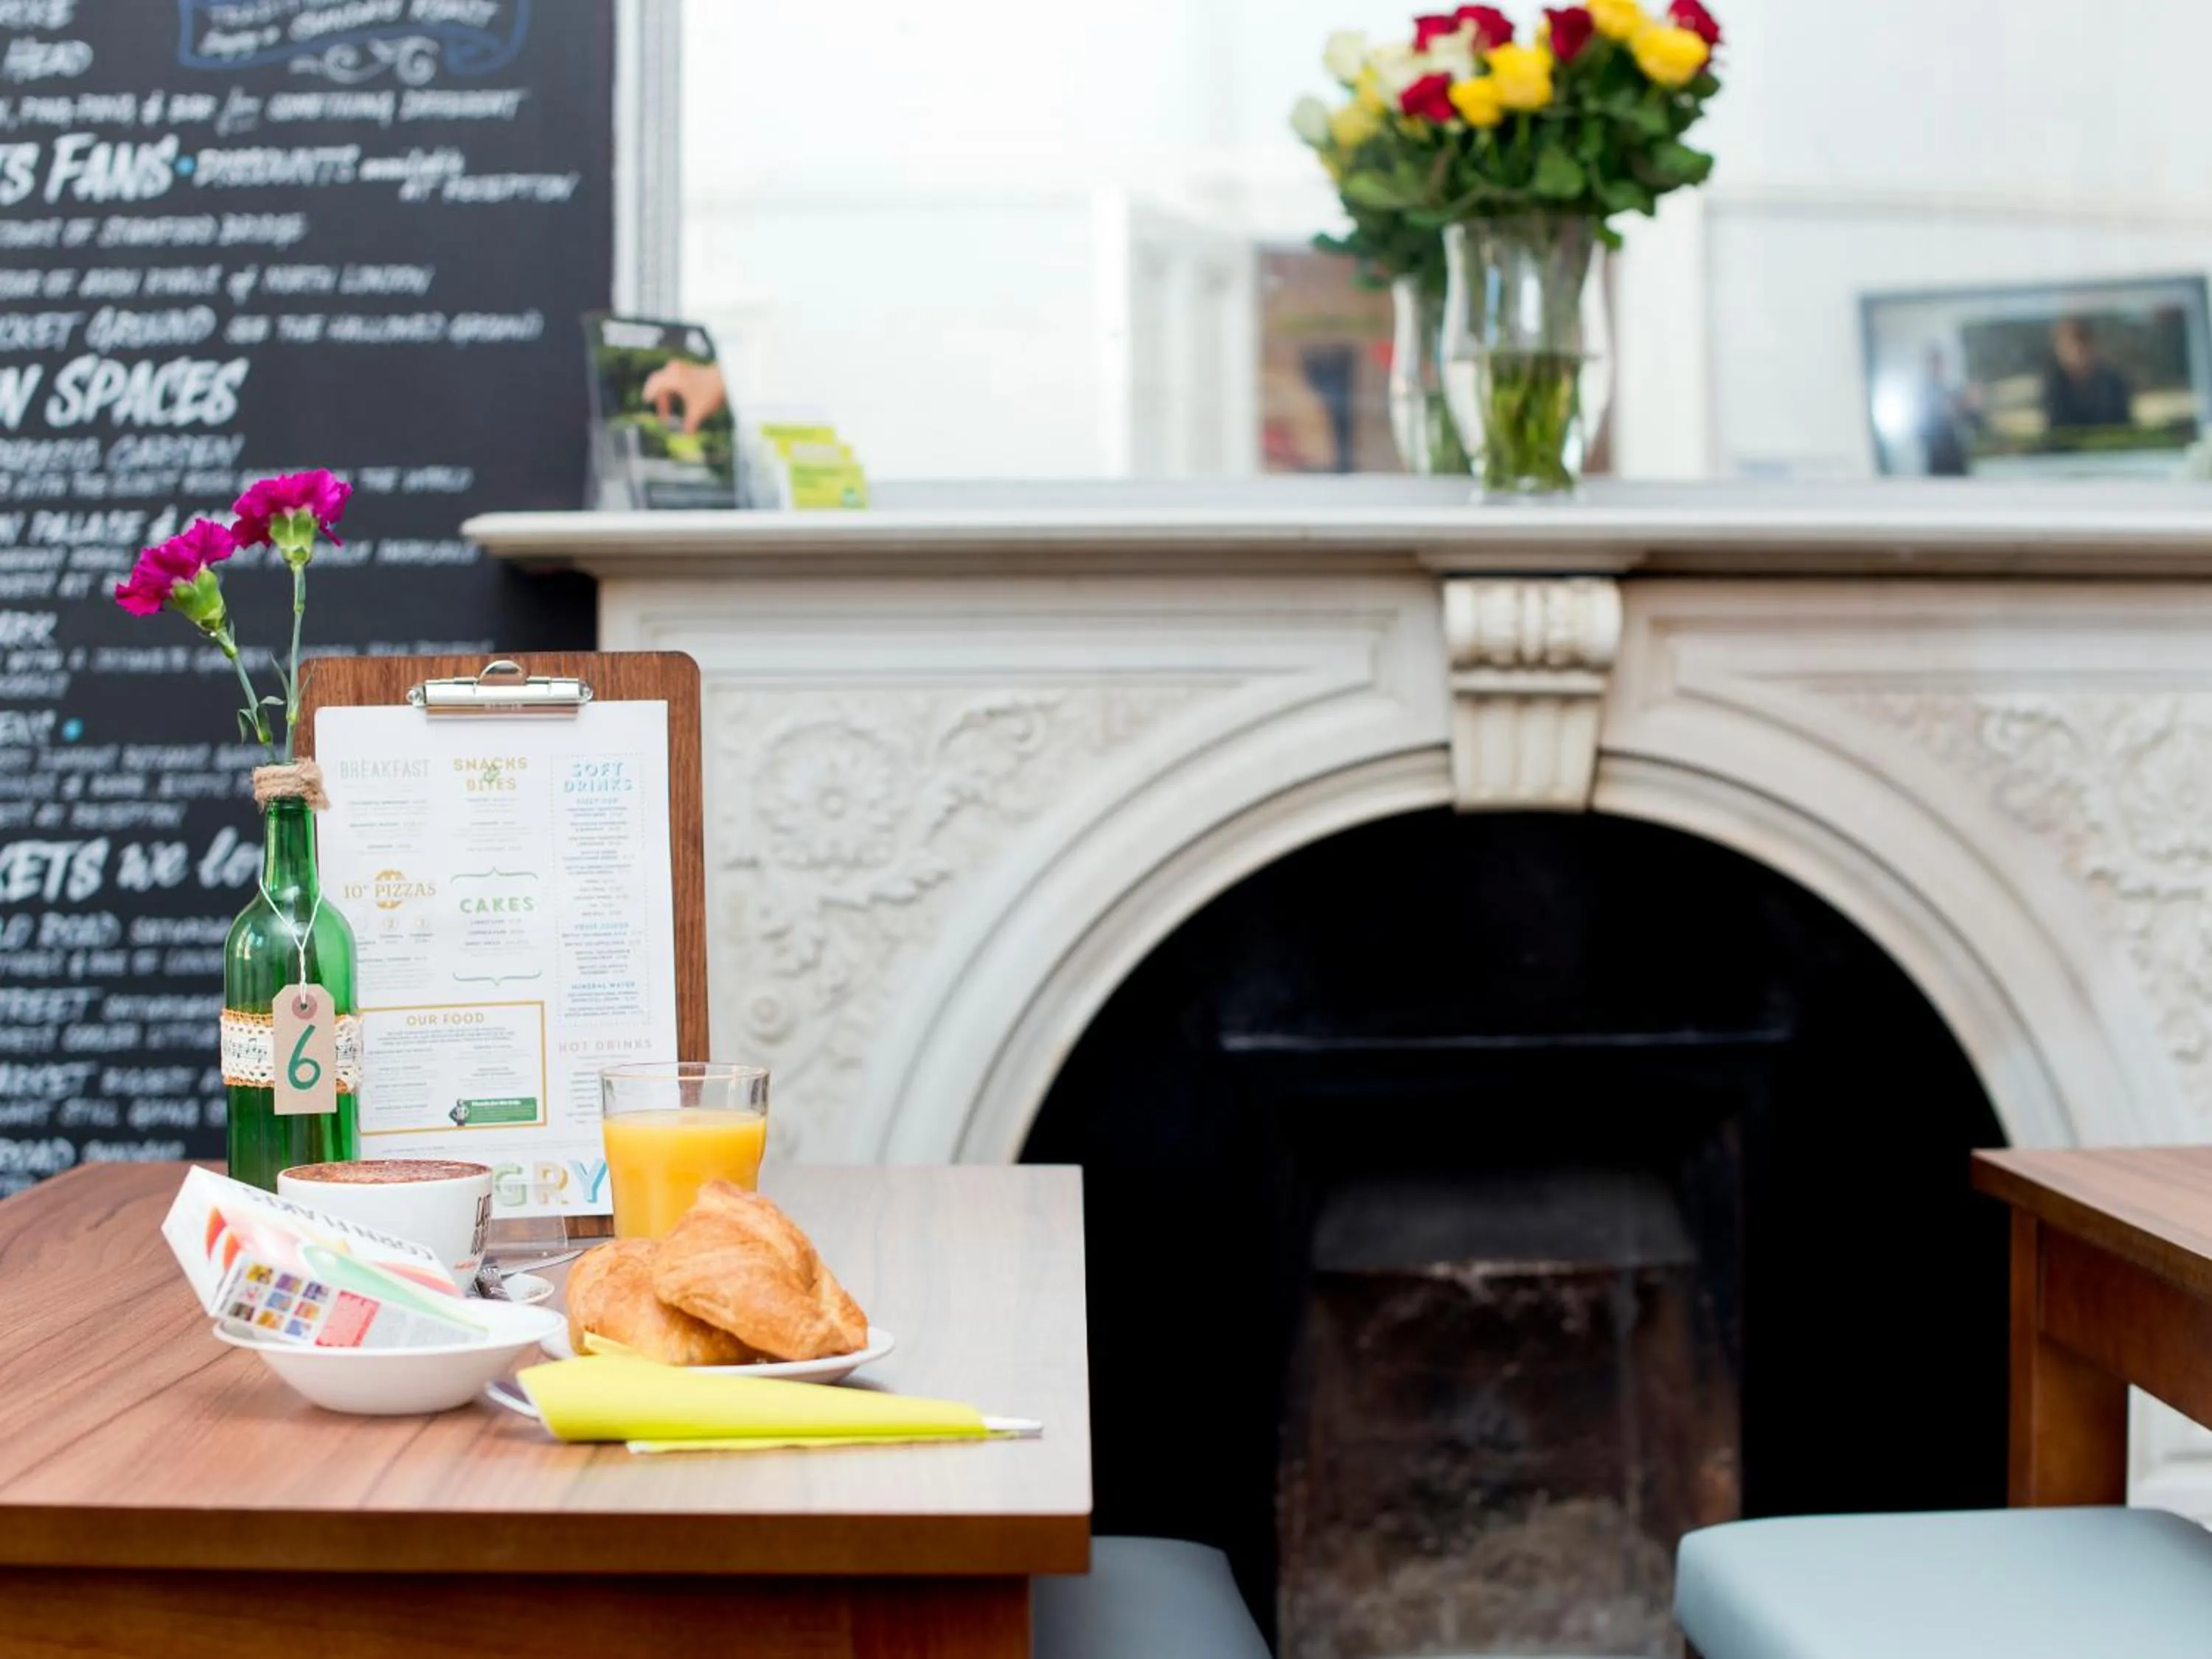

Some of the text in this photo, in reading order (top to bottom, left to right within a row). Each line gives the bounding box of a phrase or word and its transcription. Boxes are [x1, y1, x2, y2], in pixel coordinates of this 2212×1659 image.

[43, 131, 178, 204] FANS
[44, 353, 251, 429] SPACES
[340, 758, 431, 779] BREAKFAST
[453, 756, 529, 772] SNACKS
[571, 762, 624, 778] SOFT
[466, 776, 518, 792] BITES
[563, 778, 634, 793] DRINKS
[375, 881, 437, 898] PIZZAS
[459, 895, 535, 914] CAKES
[406, 1012, 485, 1027] OUR FOOD
[559, 1037, 653, 1054] HOT DRINKS
[288, 1024, 321, 1090] 6
